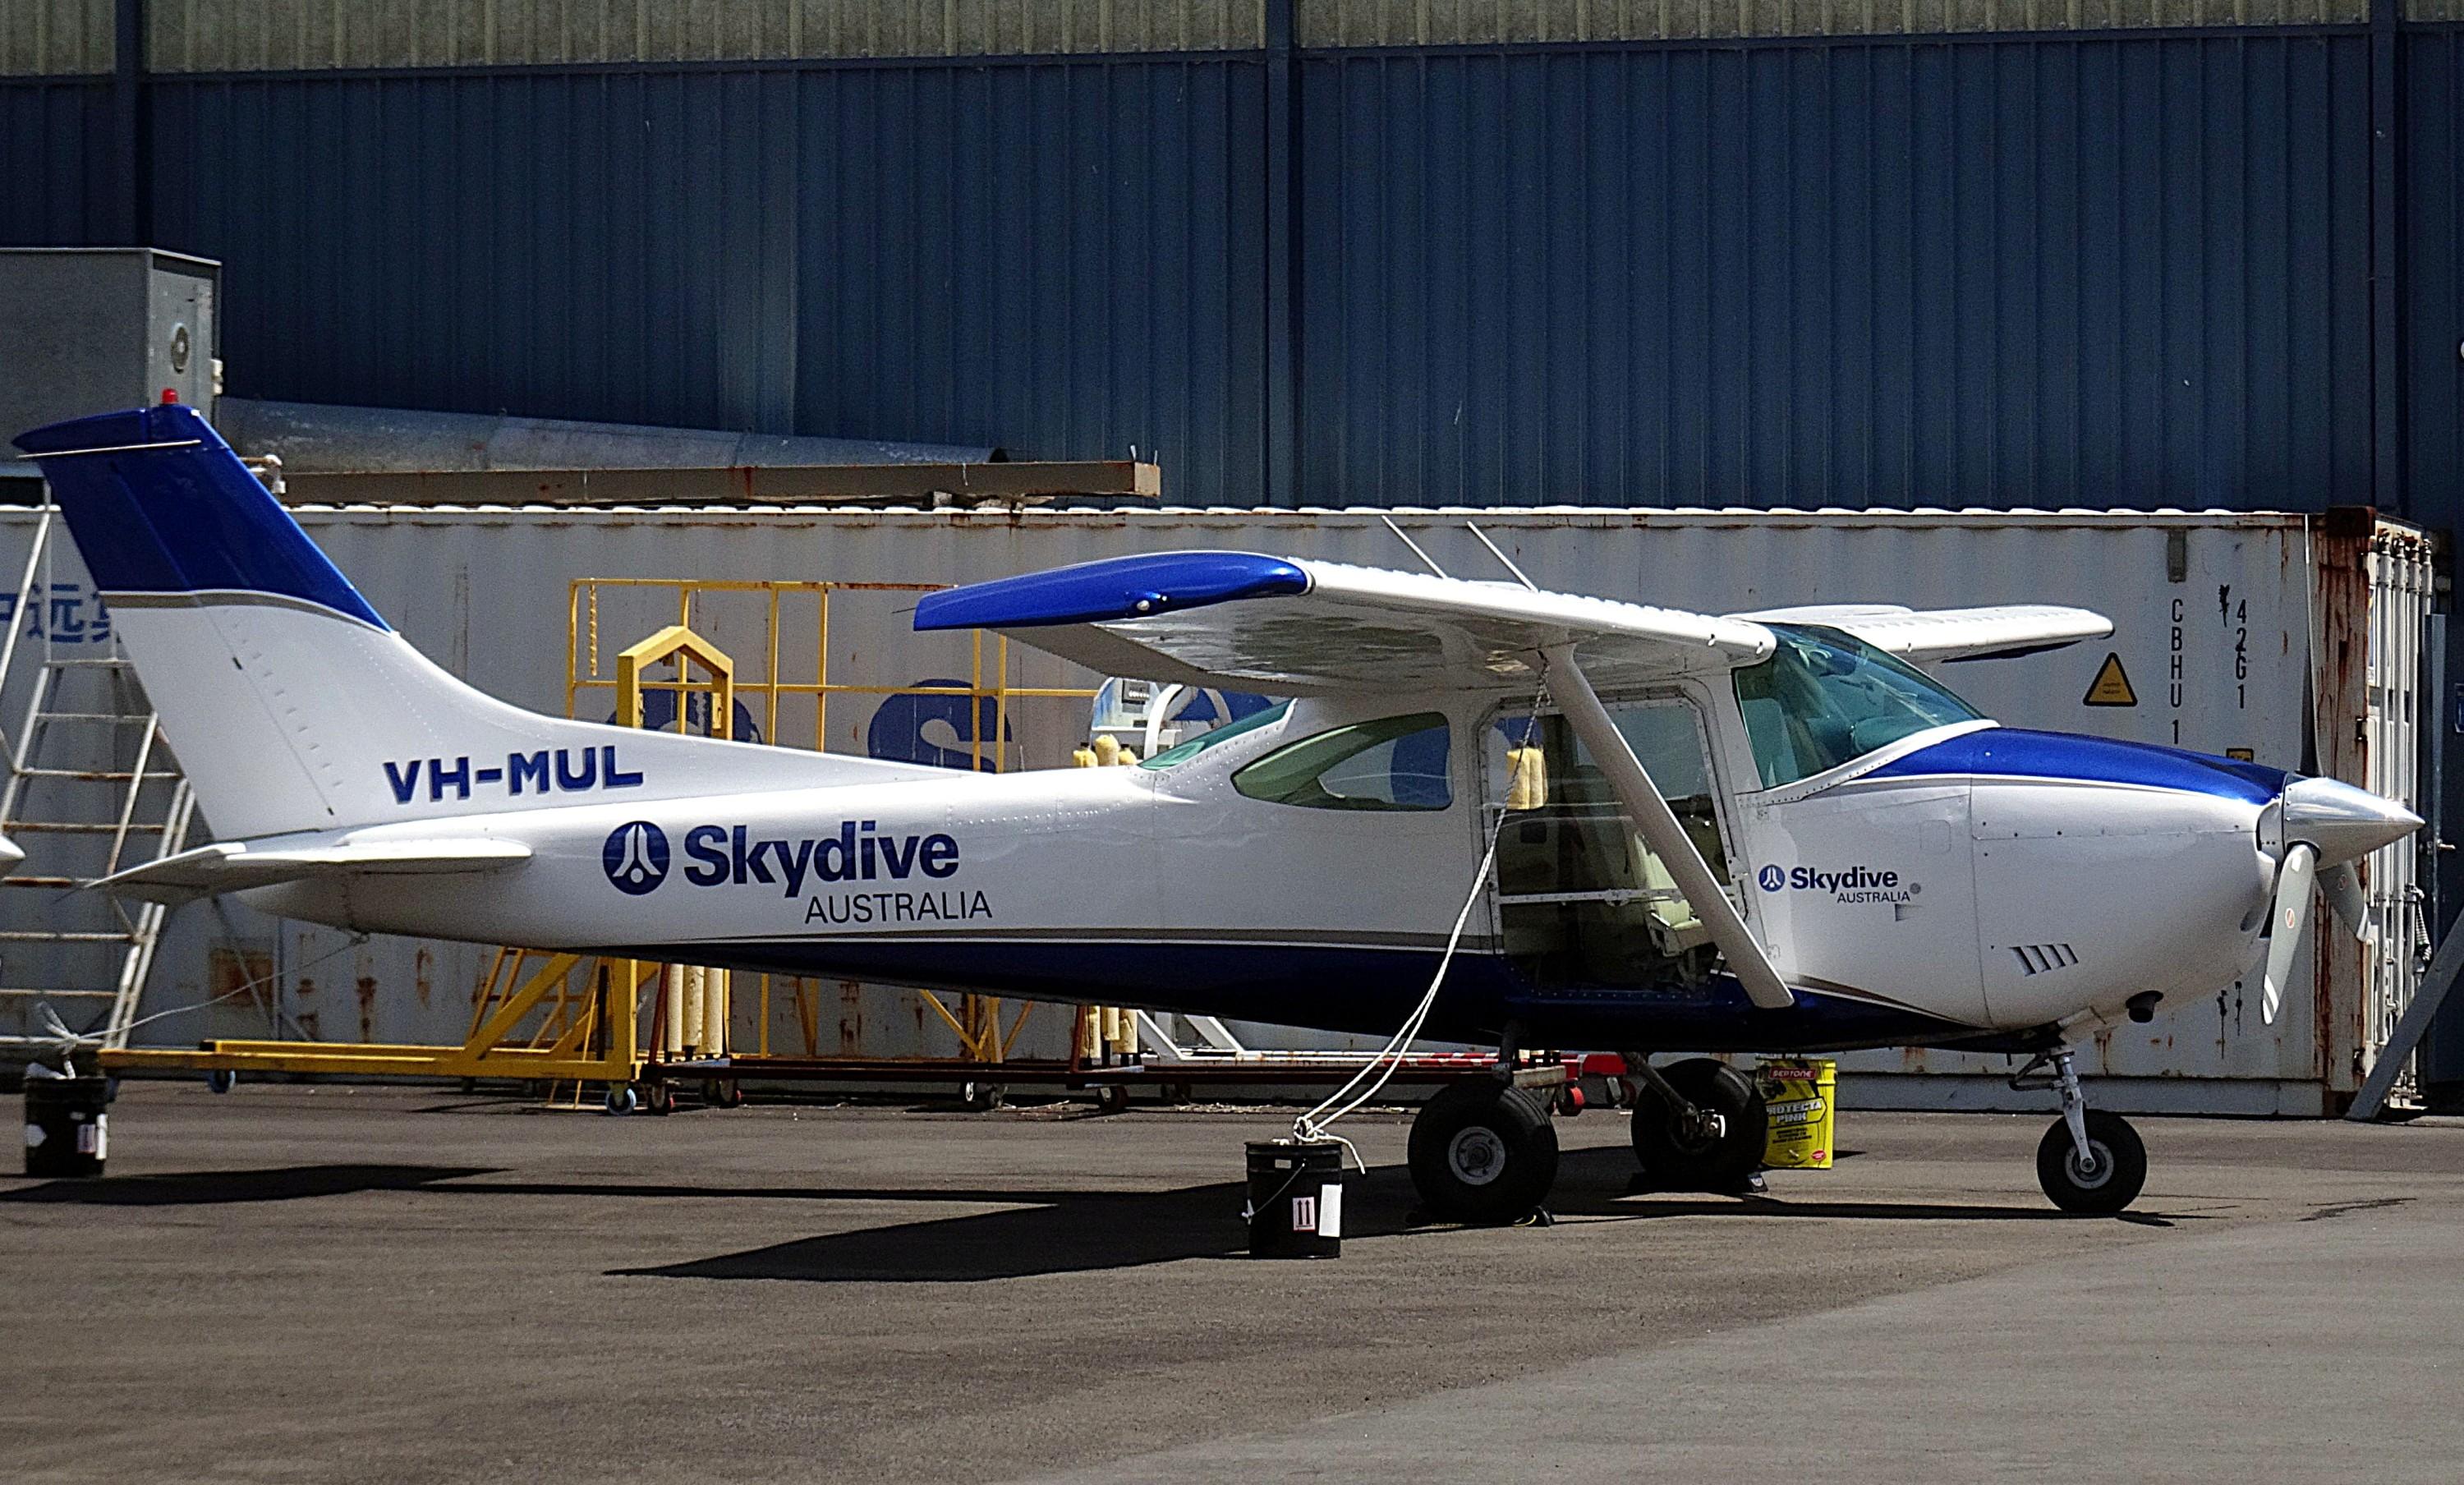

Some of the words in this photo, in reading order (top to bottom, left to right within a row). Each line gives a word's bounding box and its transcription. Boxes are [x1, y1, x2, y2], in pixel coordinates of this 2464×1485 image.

[2171, 598, 2183, 708] CBHU
[2235, 599, 2247, 709] 42G1
[383, 745, 644, 805] VH-MUL
[683, 820, 959, 898] Skydive
[1790, 866, 1898, 894] Skydive
[804, 890, 992, 925] AUSTRALIA
[1837, 891, 1910, 903] AUSTRALIA
